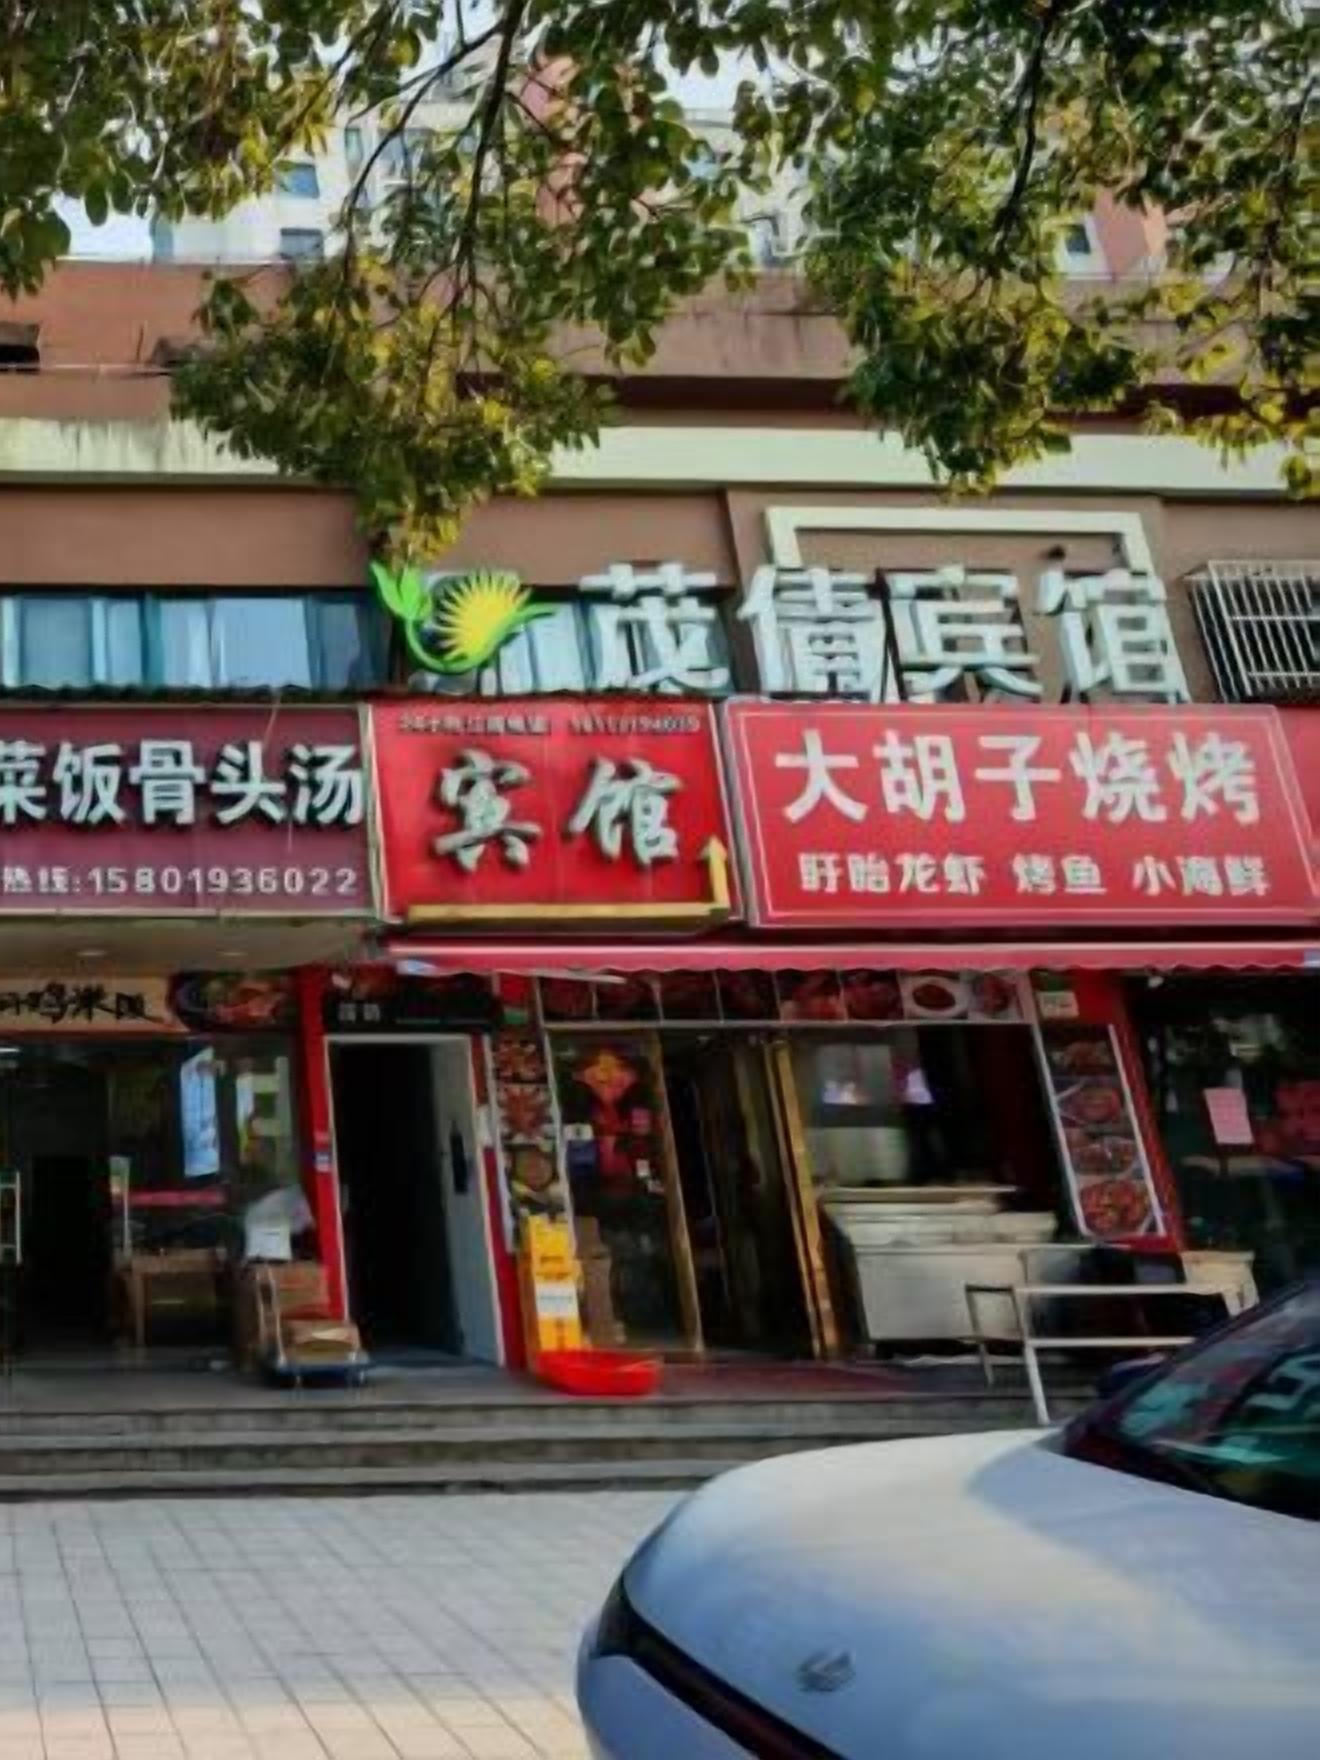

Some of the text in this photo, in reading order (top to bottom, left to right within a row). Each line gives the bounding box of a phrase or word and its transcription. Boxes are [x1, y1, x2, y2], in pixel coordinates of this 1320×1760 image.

[434, 747, 684, 873] 宾馆
[774, 728, 1260, 826] 大胡子烧烤
[797, 851, 1270, 897] 盱眙龙虾 烤鱼 小海鲜
